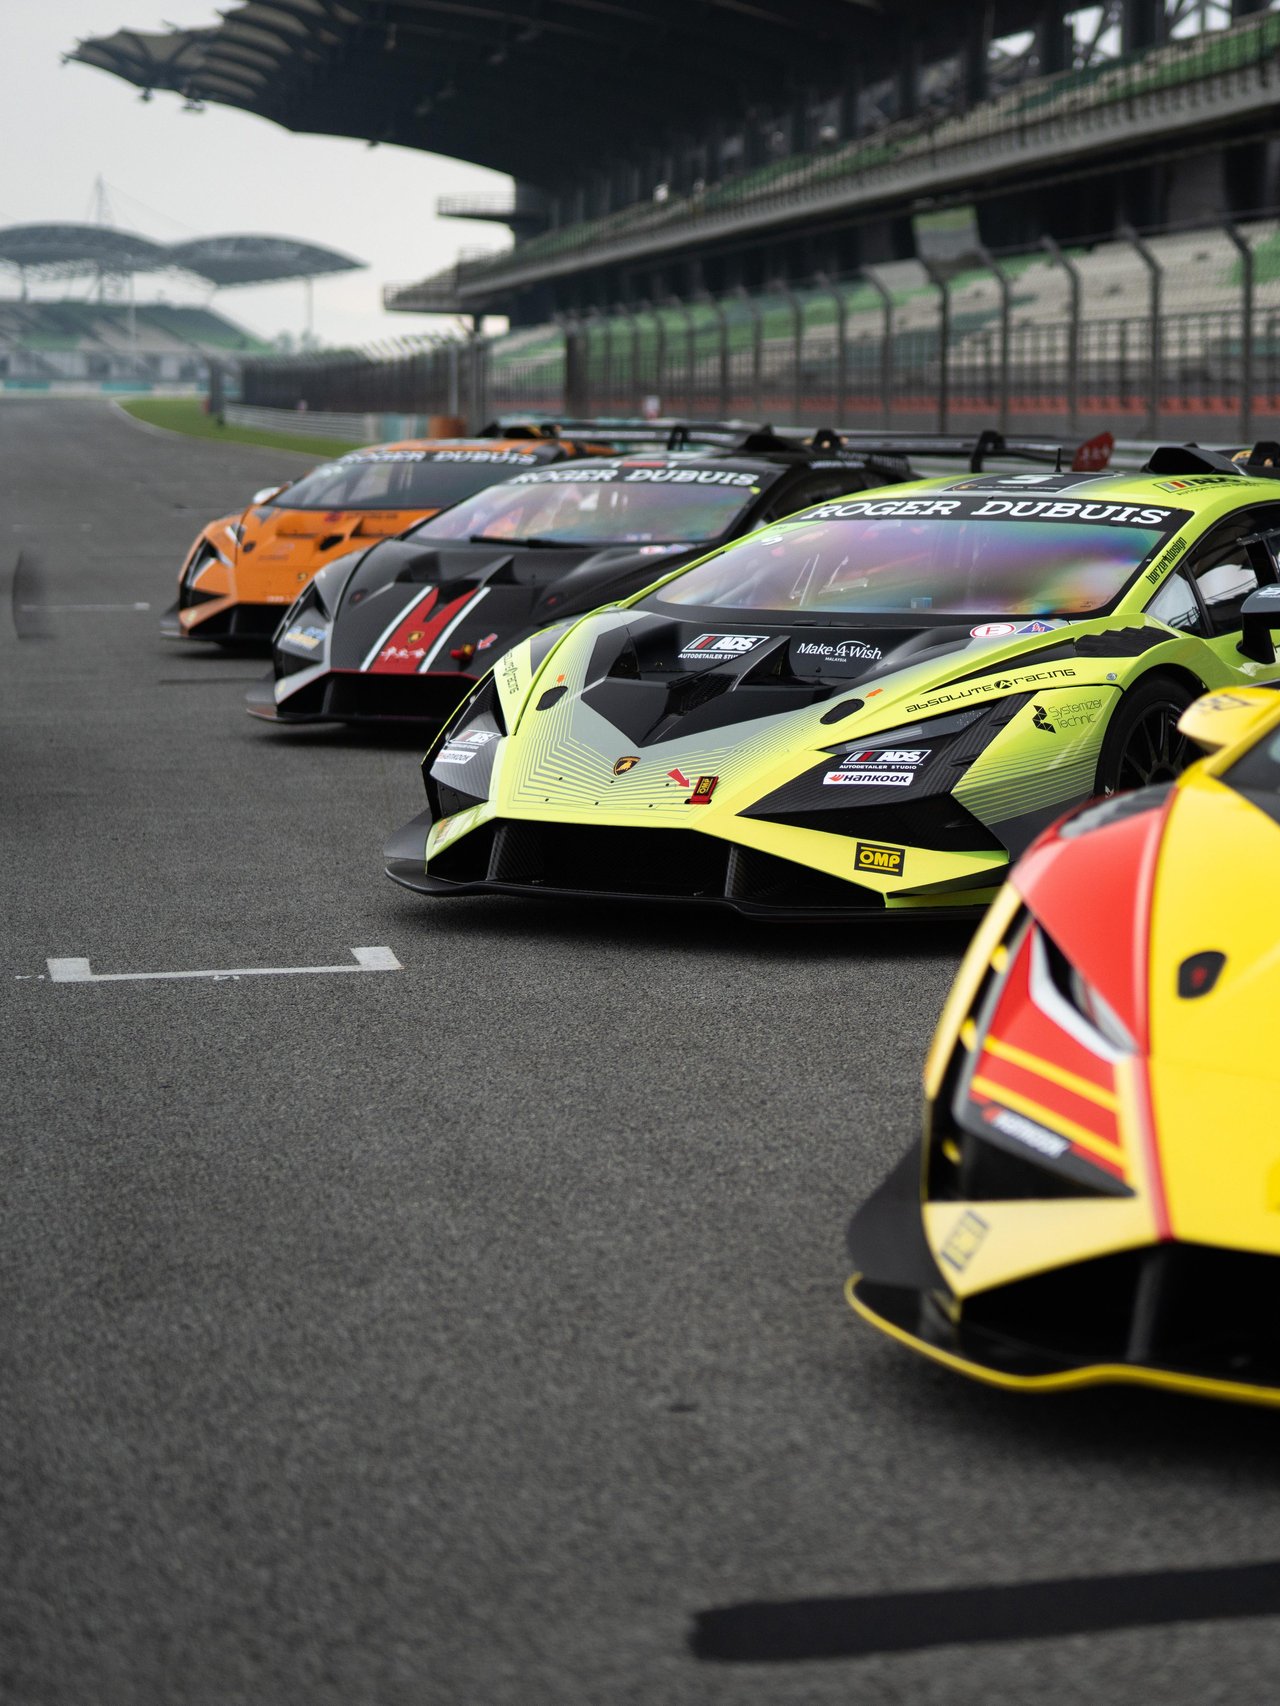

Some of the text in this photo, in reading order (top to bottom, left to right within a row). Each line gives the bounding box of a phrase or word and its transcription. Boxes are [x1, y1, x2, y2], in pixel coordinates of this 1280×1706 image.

[509, 468, 760, 487] ROGER DUBUIS
[800, 499, 1172, 525] ROGER DUBUIS
[714, 636, 757, 651] ADS
[1047, 699, 1104, 719] Systemizer
[1055, 712, 1097, 730] Technic
[876, 751, 922, 762] ADS
[859, 850, 901, 869] OMP
